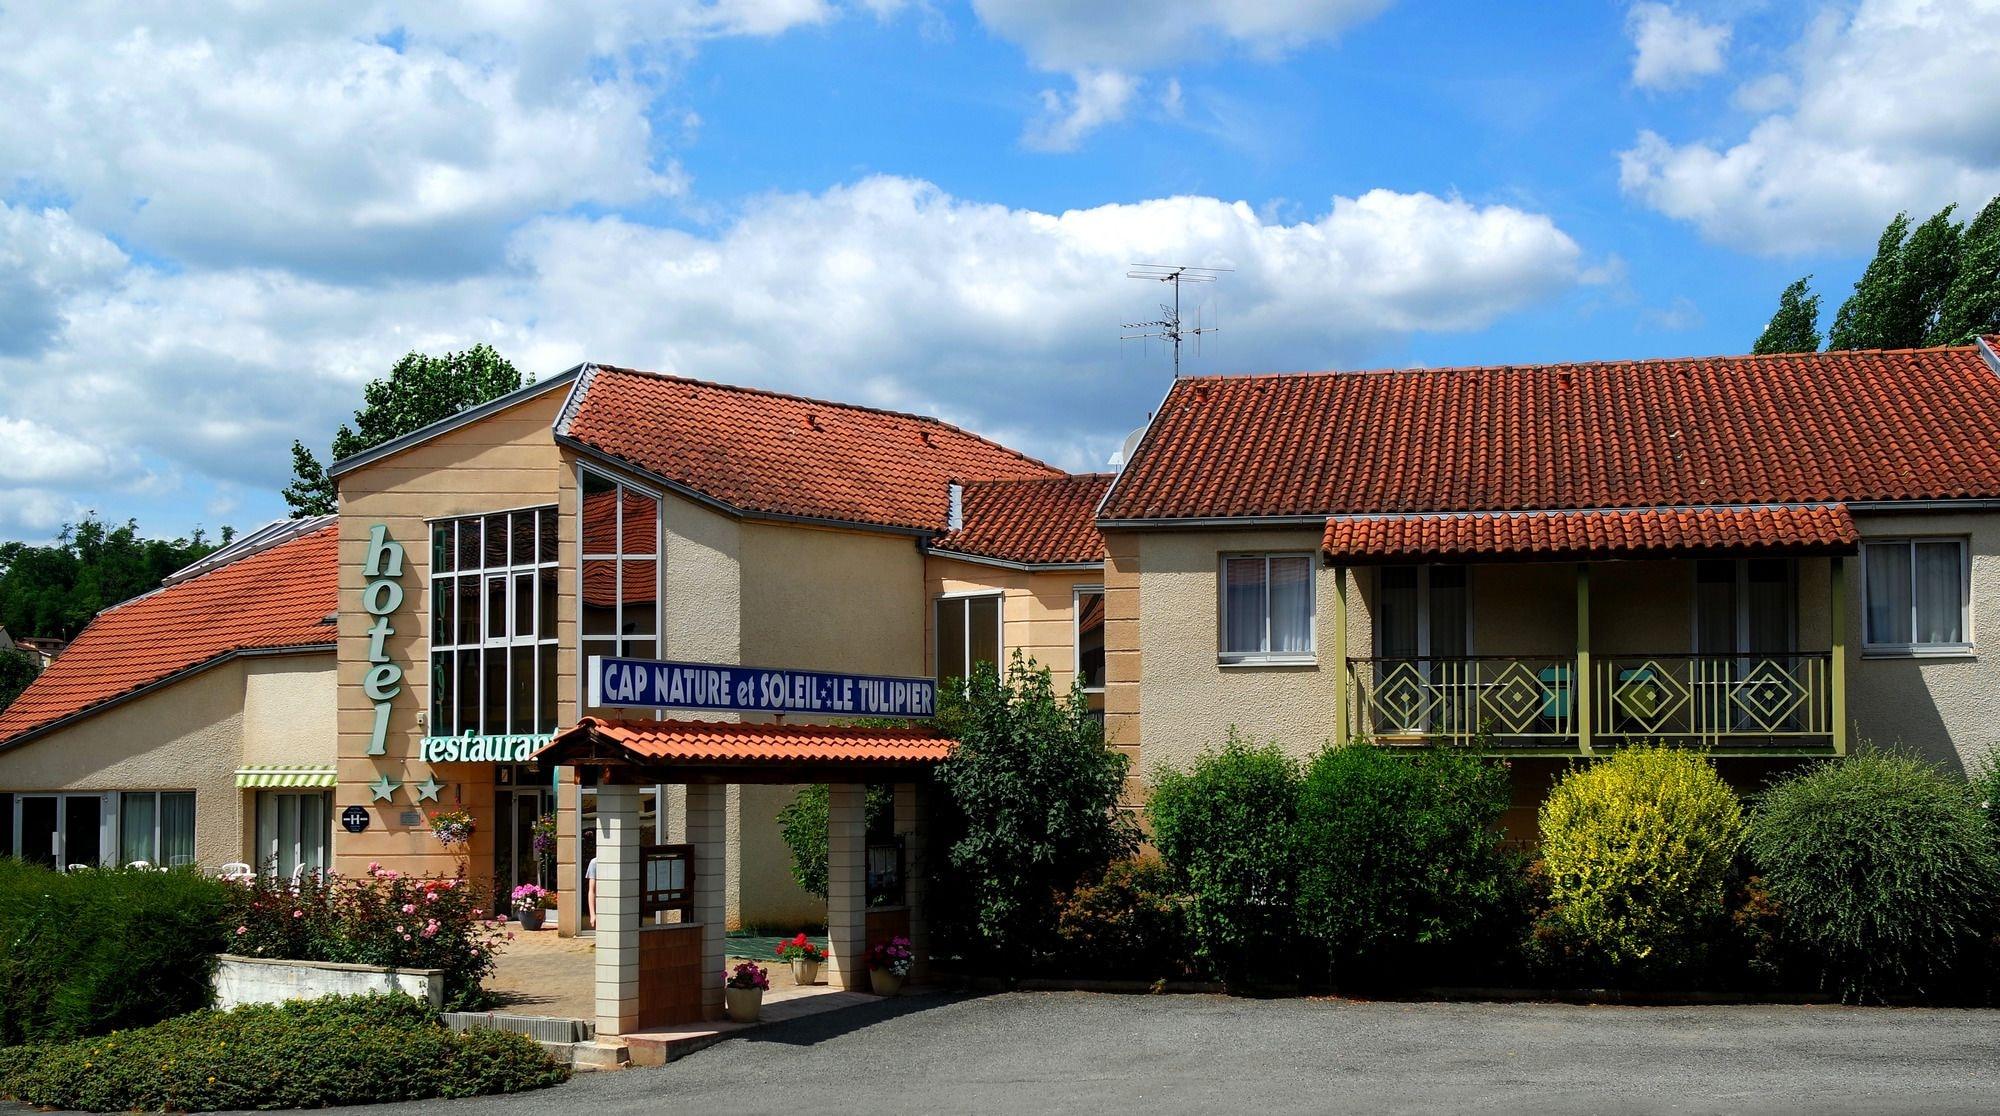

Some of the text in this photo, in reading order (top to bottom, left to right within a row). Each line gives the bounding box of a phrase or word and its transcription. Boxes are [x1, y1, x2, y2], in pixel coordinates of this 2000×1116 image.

[363, 524, 405, 757] hotel
[604, 663, 933, 715] CAP NATURE et SOLEIL LE TULIPIER
